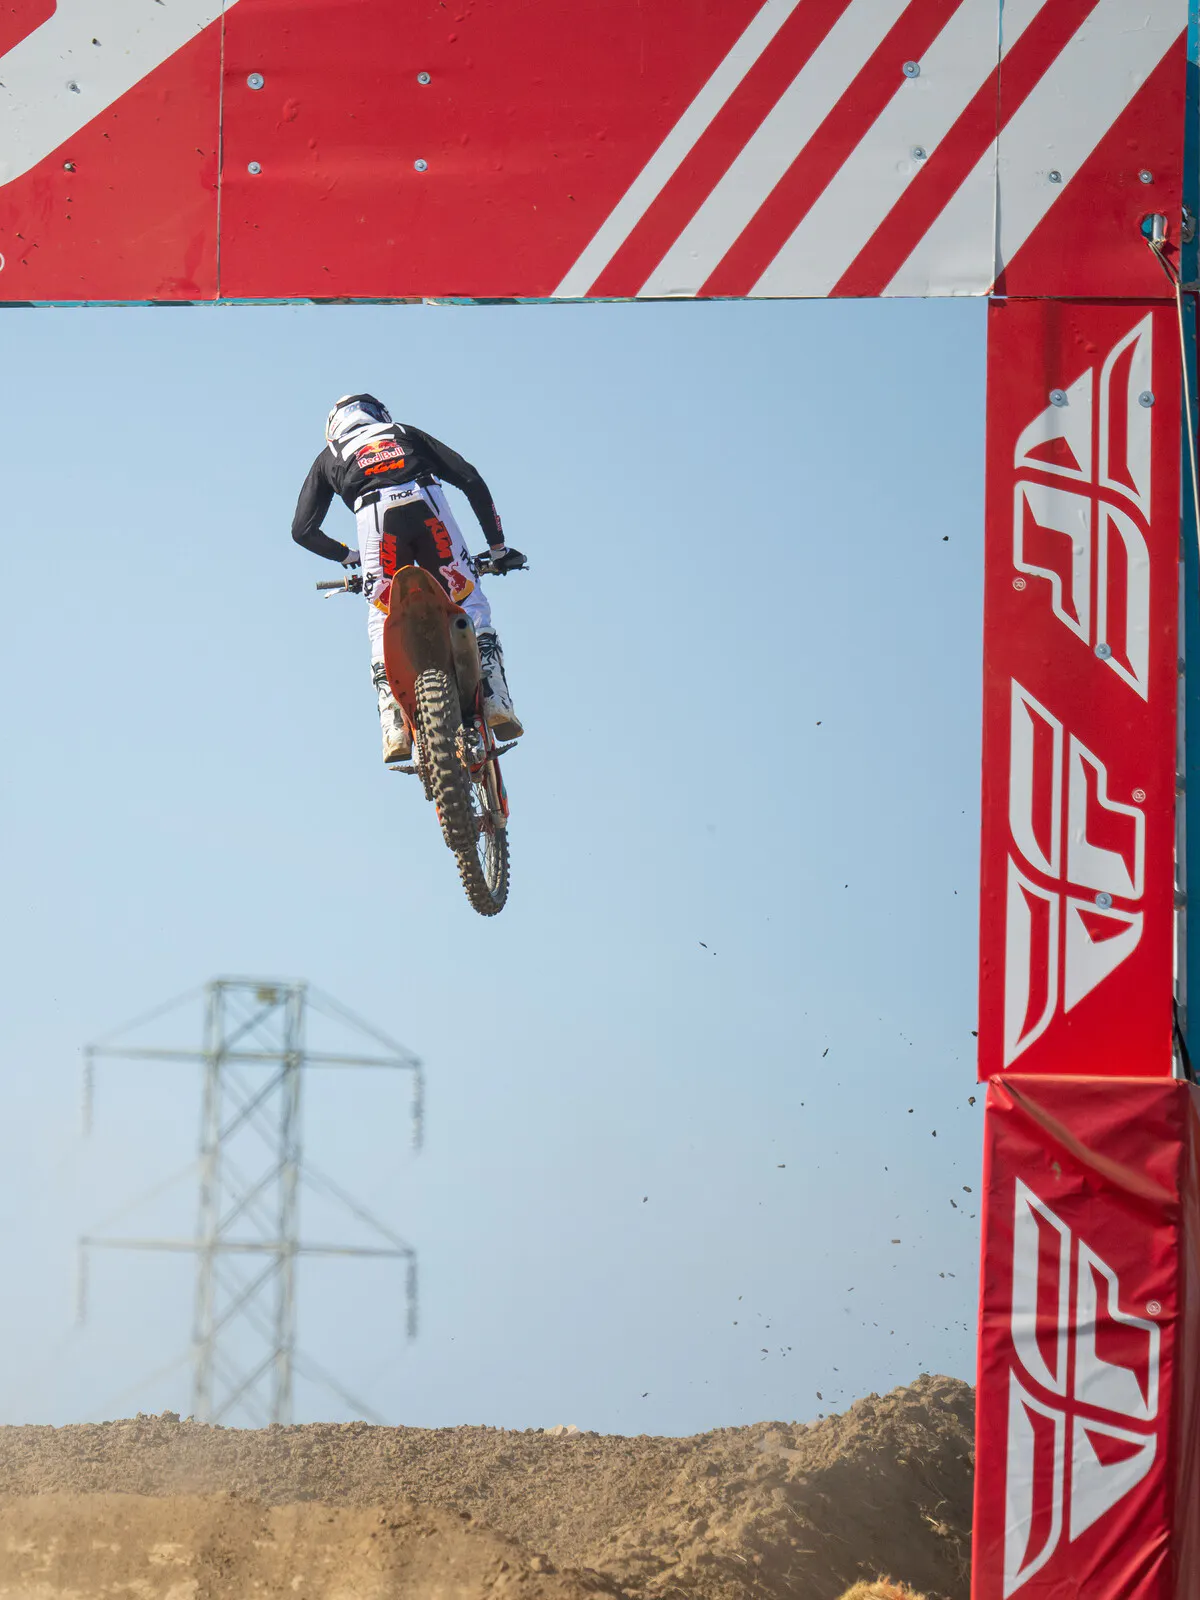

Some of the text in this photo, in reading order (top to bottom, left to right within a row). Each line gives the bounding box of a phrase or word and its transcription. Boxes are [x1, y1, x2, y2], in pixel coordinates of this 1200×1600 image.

[358, 446, 405, 469] Red Bull
[364, 458, 405, 477] KTM
[389, 489, 414, 501] THOR
[424, 517, 453, 559] KTM
[379, 532, 397, 577] KTM
